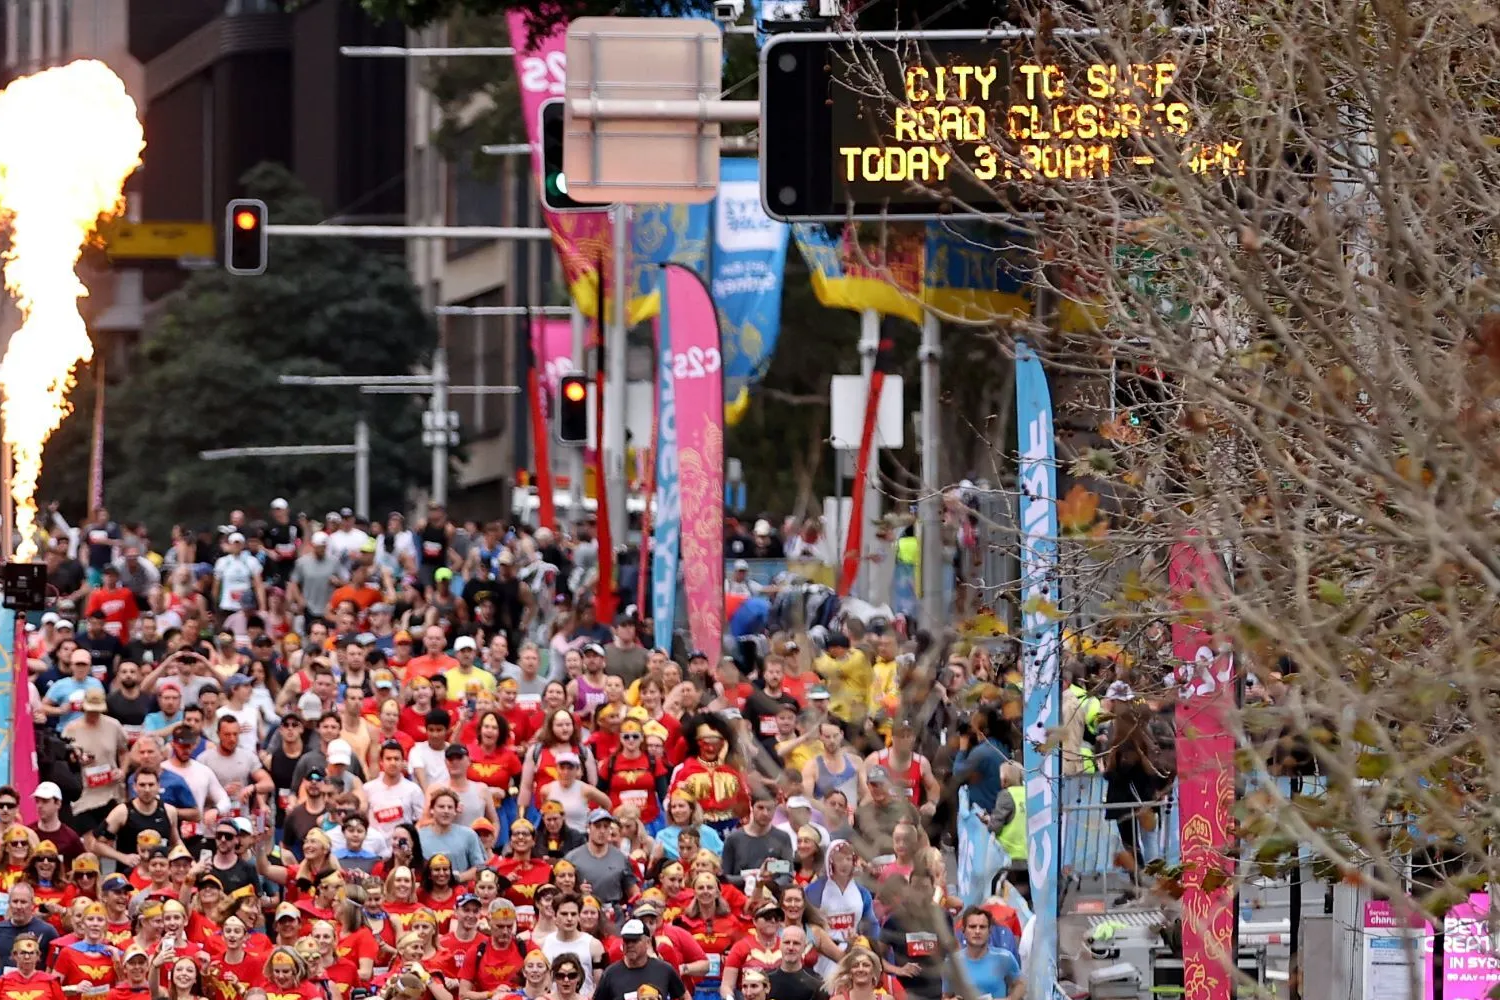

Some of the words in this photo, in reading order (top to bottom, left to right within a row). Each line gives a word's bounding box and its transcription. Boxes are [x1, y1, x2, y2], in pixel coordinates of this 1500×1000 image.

[906, 65, 997, 102] CITY
[1020, 64, 1064, 99] TO
[895, 106, 987, 142] ROAD
[839, 146, 951, 182] TODAY
[1370, 915, 1398, 926] chang
[1449, 957, 1464, 969] IN
